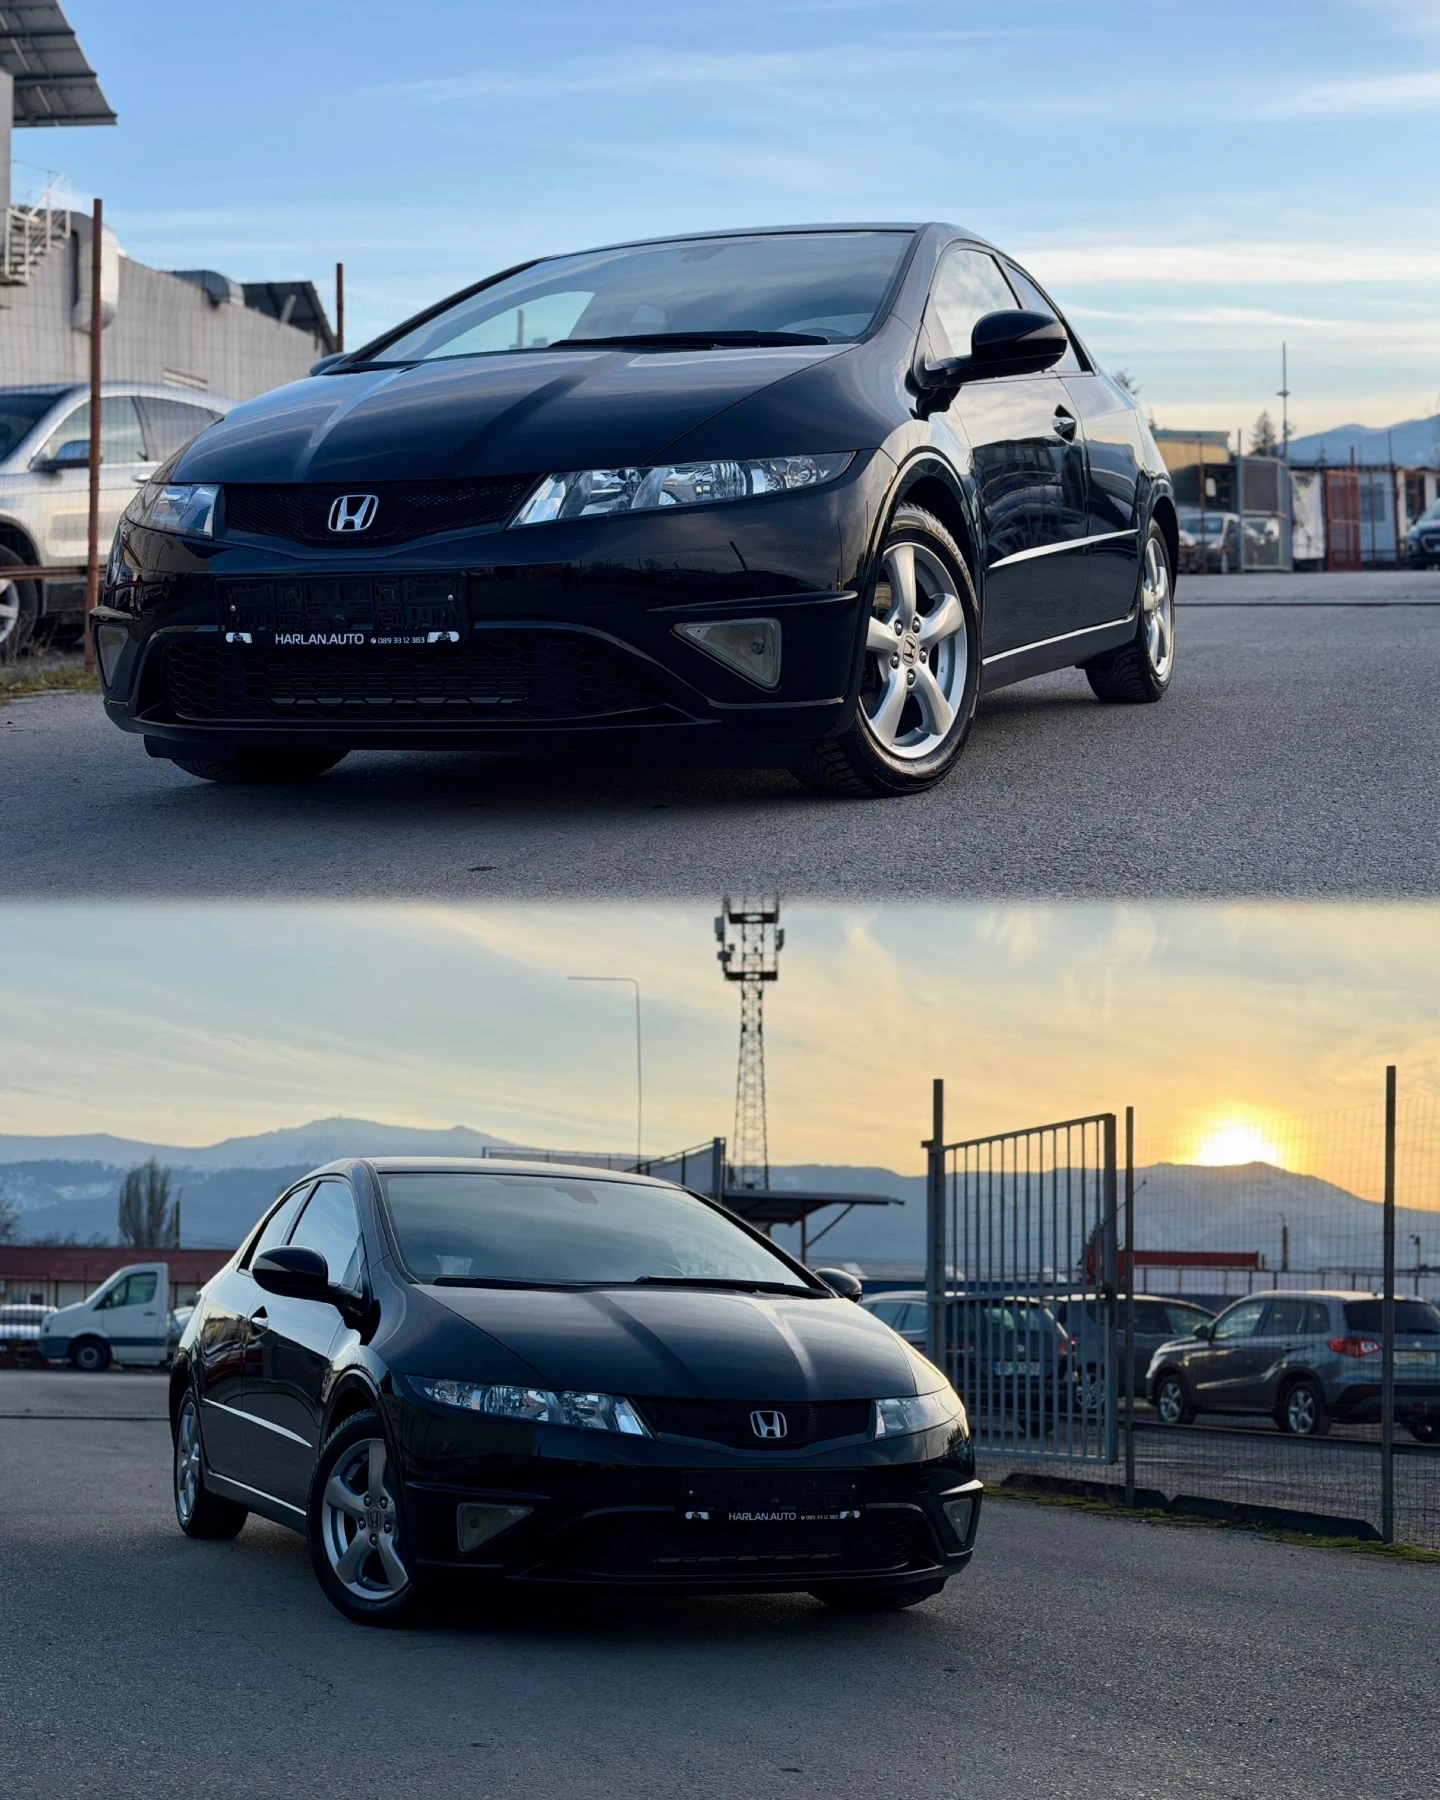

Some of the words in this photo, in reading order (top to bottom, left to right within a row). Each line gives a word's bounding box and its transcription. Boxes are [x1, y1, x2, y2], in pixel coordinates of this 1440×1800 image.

[275, 633, 364, 645] HARLAN.AUTO
[411, 636, 425, 644] 383
[728, 1512, 797, 1521] HARLAN.AUTO
